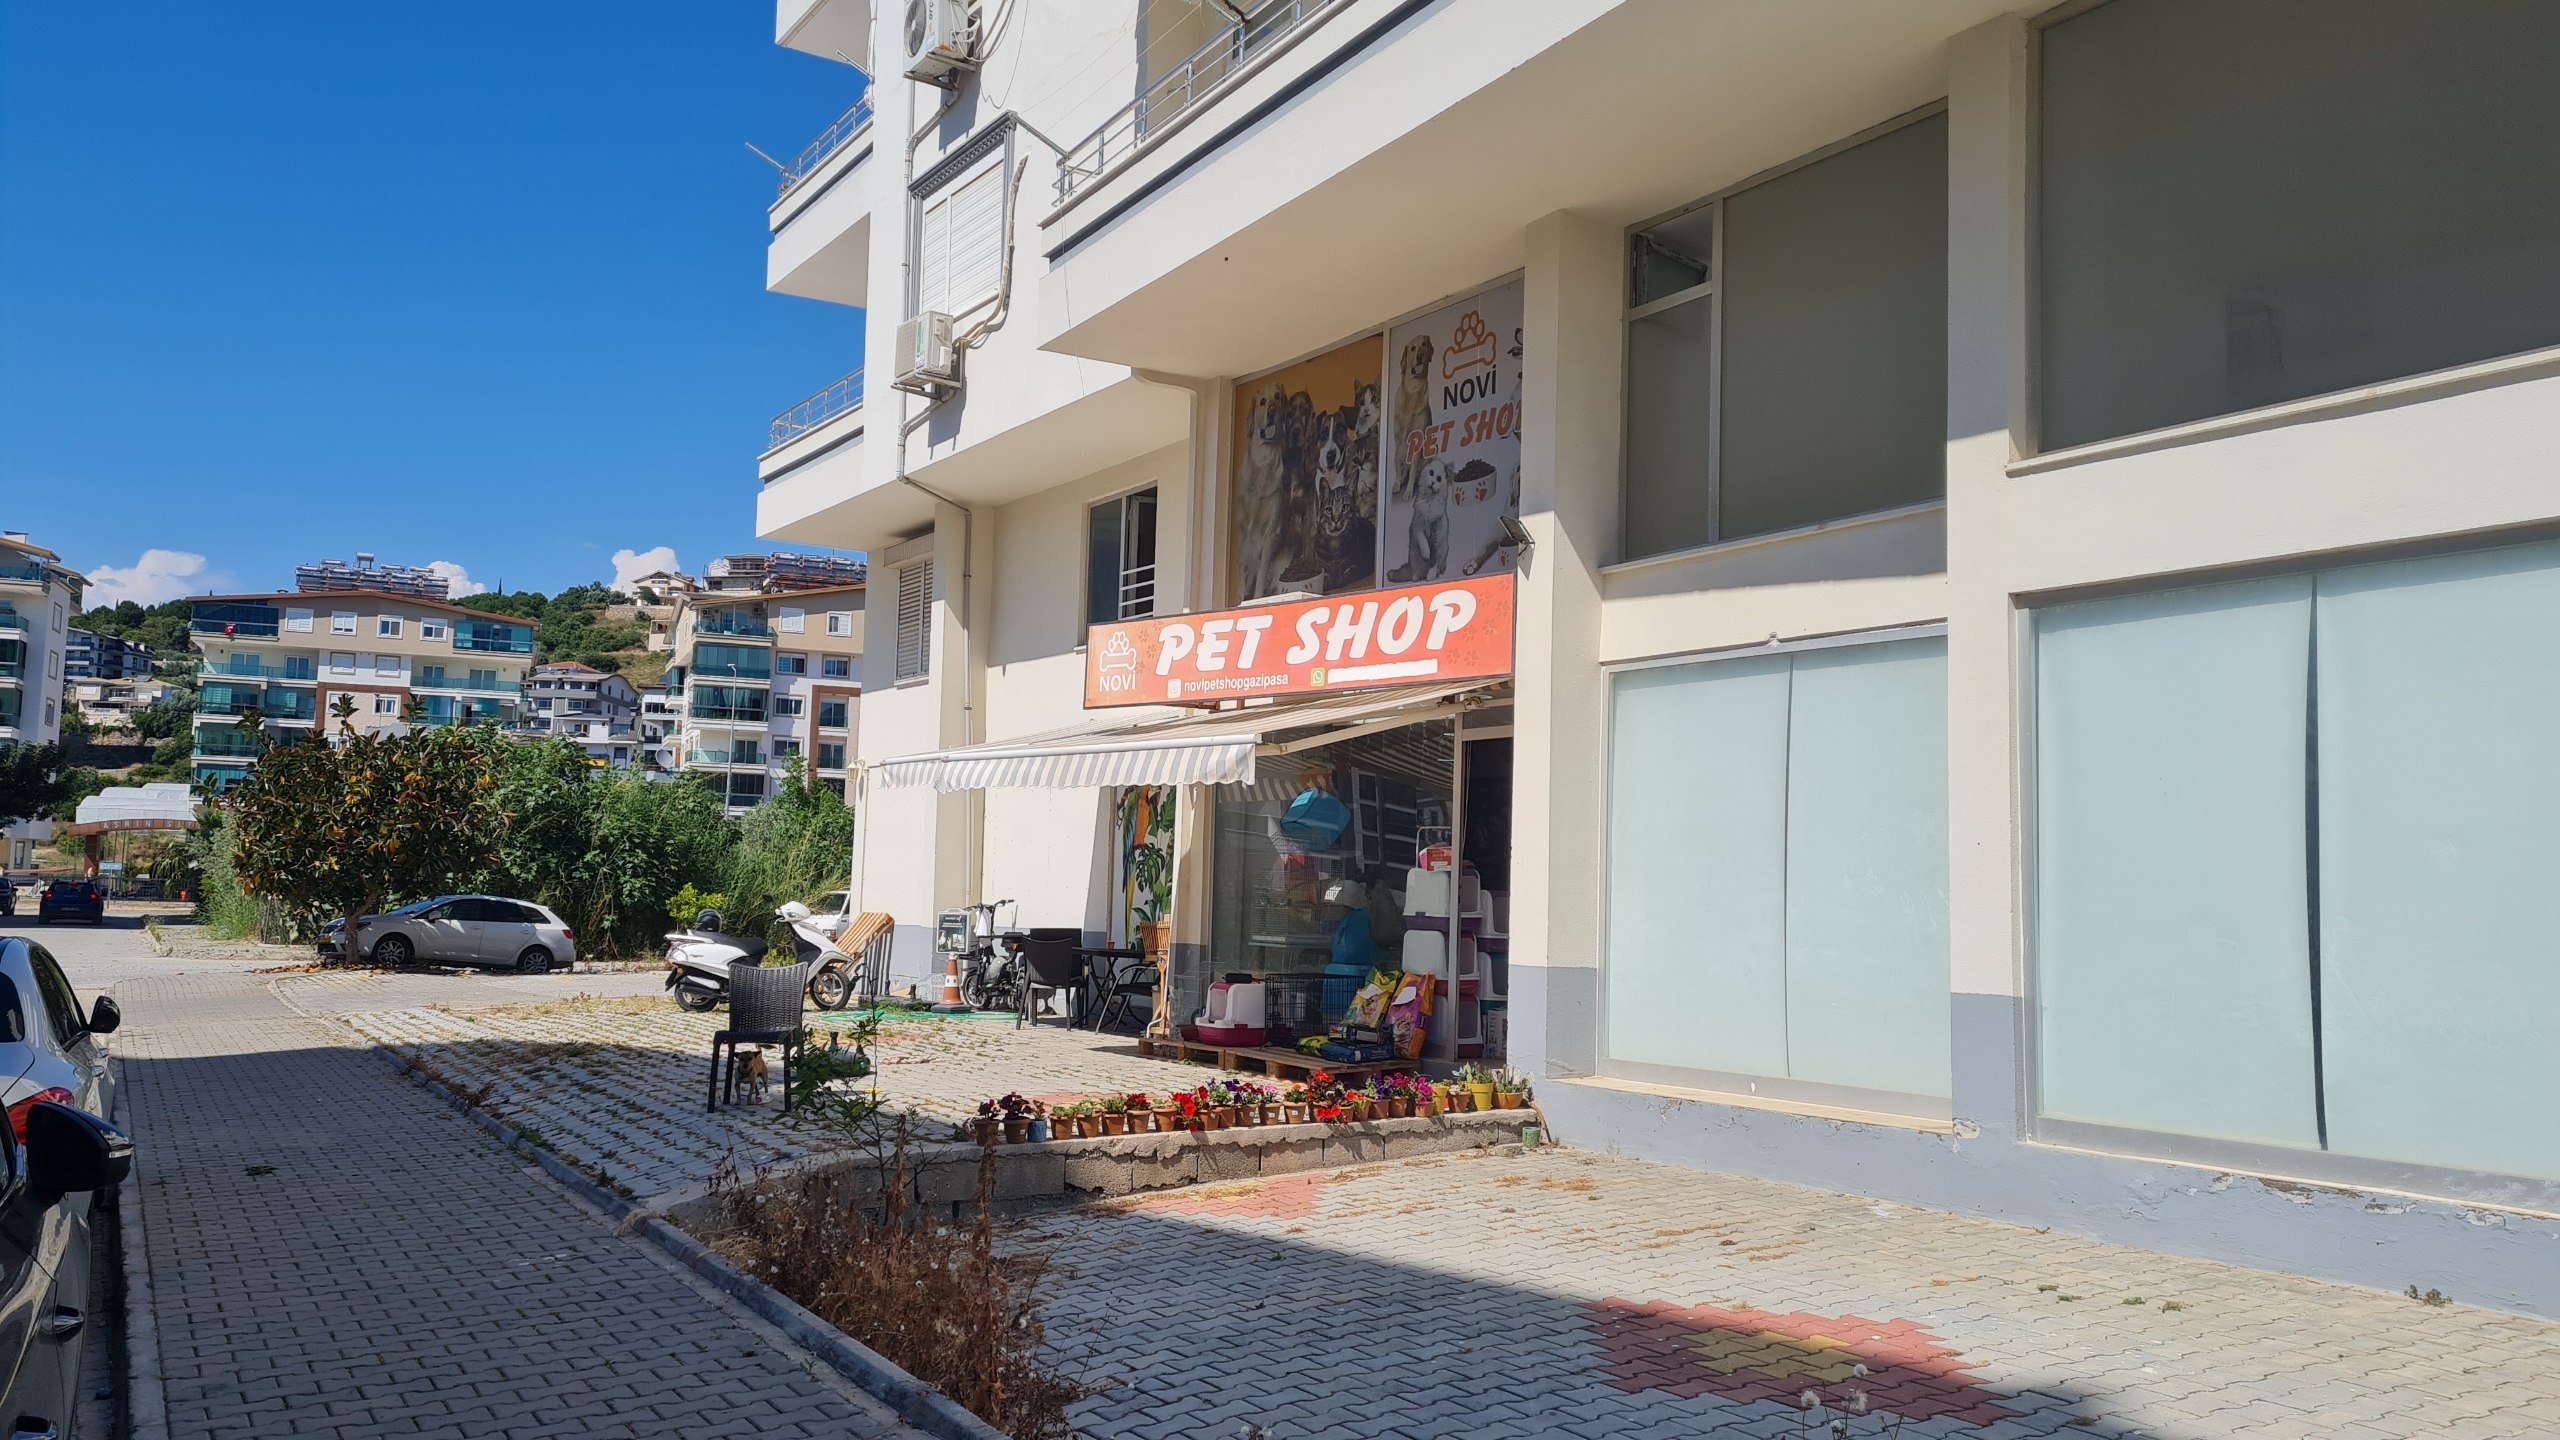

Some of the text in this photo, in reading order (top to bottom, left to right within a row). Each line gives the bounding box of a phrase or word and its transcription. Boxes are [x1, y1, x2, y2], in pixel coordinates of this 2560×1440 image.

[1405, 420, 1456, 464] PET
[1155, 589, 1477, 676] PET SHOP
